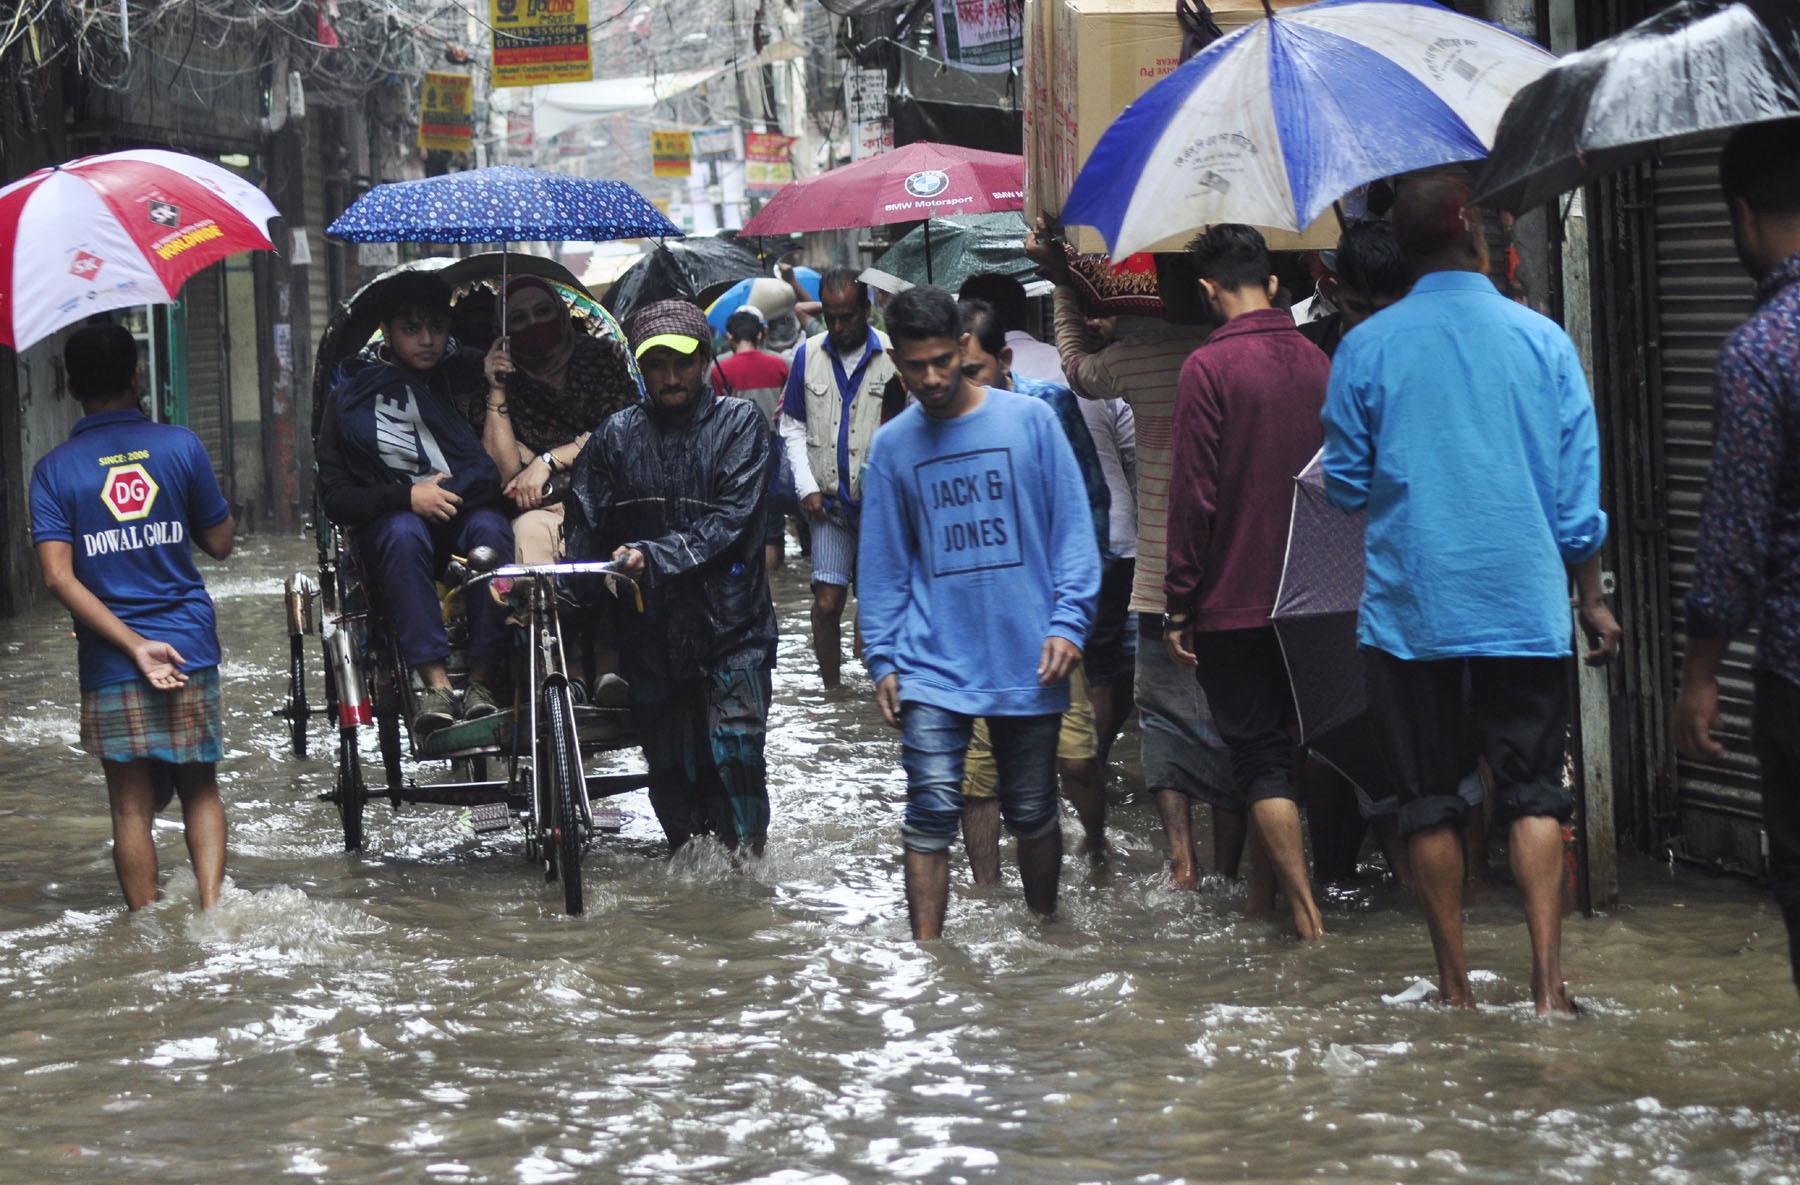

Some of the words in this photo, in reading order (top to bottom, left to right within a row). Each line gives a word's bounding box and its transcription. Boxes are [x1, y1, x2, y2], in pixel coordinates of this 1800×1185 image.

[884, 200, 912, 212] BMW
[914, 195, 974, 208] Motorsport
[155, 223, 225, 261] WORLDWIDE
[374, 392, 420, 475] NIKE
[115, 479, 145, 505] DG
[930, 474, 982, 510] JACK
[985, 469, 1003, 501] &
[83, 526, 143, 557] DOWAL
[143, 521, 183, 547] GOLD
[943, 516, 1008, 553] JONES
